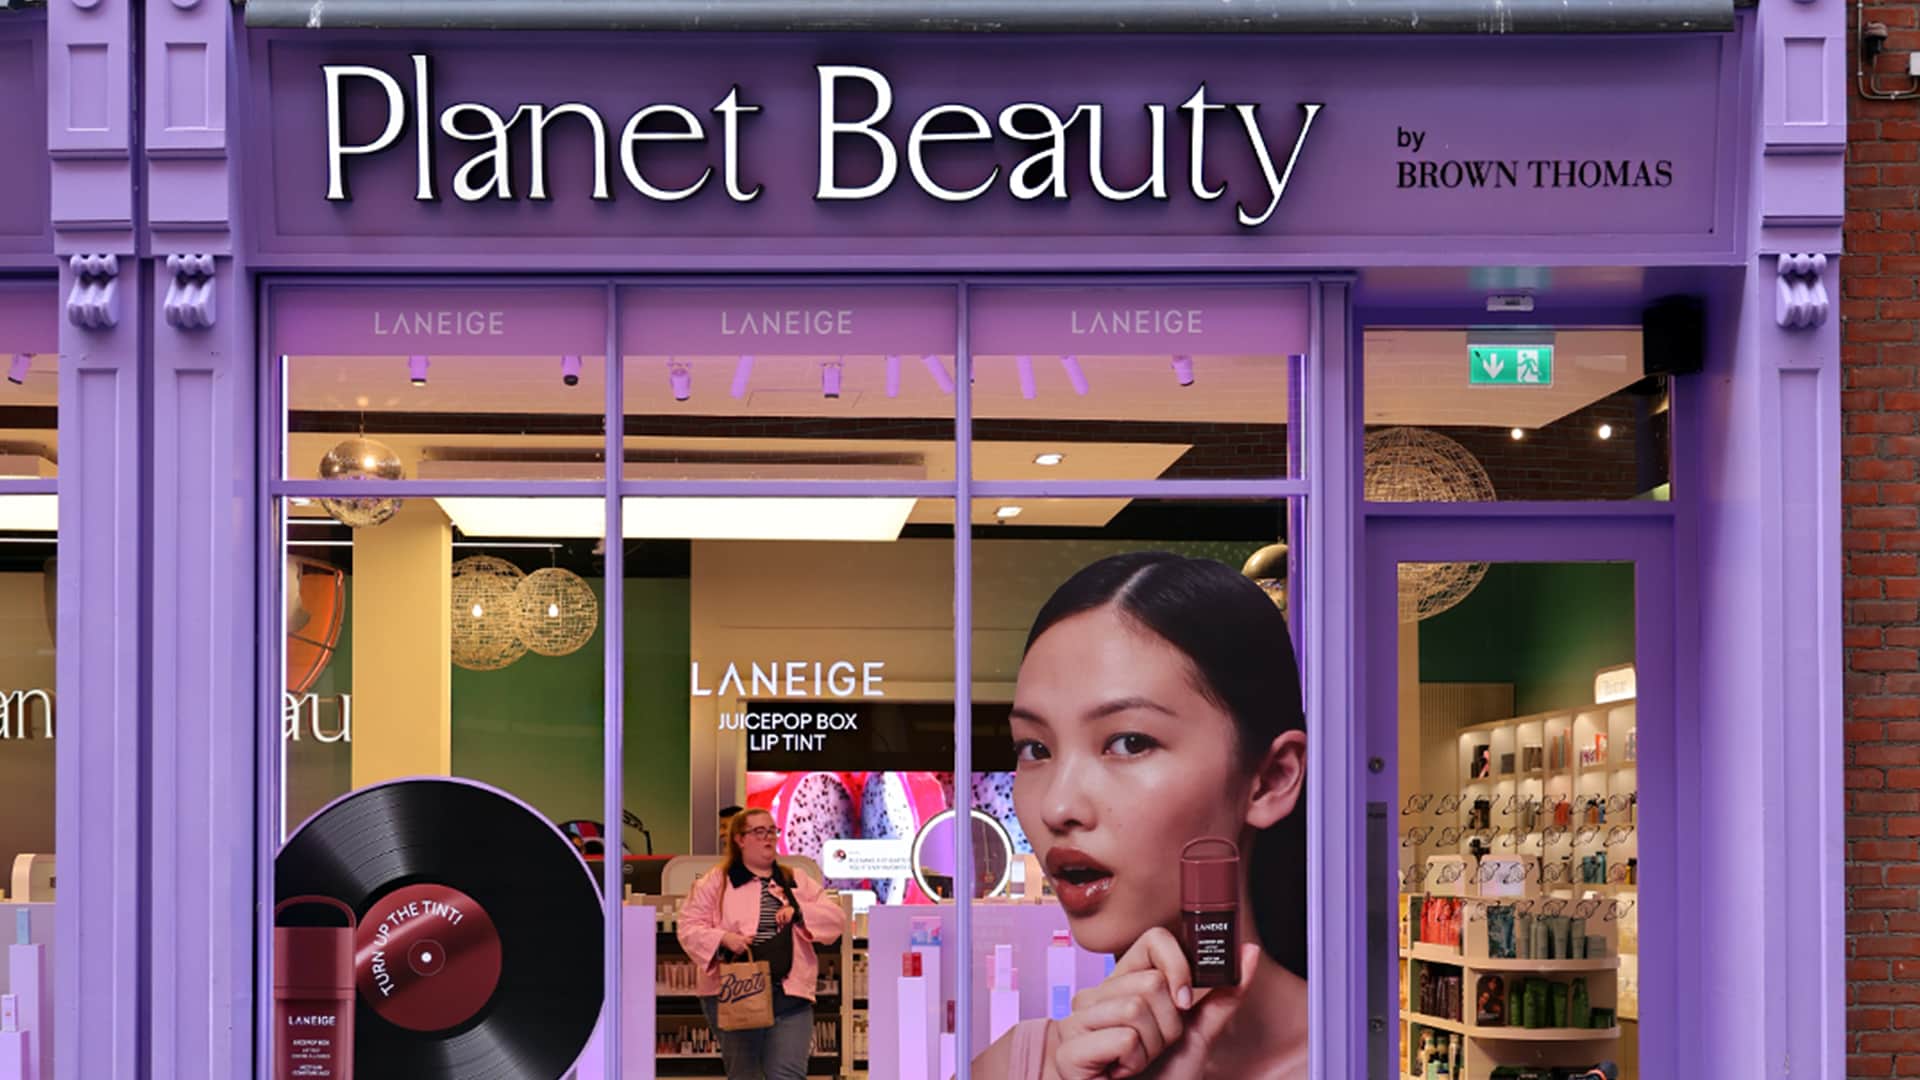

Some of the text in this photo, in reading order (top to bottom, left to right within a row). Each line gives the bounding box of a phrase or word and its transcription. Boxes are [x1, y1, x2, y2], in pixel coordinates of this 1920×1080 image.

[322, 54, 1325, 227] Planet Beauty
[1397, 126, 1426, 152] by
[1396, 160, 1673, 188] BROWN THOMAS
[374, 311, 504, 335] LANEIGE
[721, 310, 853, 335] LANEIGE
[1072, 310, 1203, 334] LANEIGE
[691, 661, 885, 697] LANEIGE
[718, 713, 858, 730] JUICEPOP BOX
[750, 734, 827, 751] LIP TINT
[371, 900, 464, 996] TURN UP THE TINT!
[719, 972, 766, 1004] Boots
[288, 1015, 336, 1026] LANEIGE
